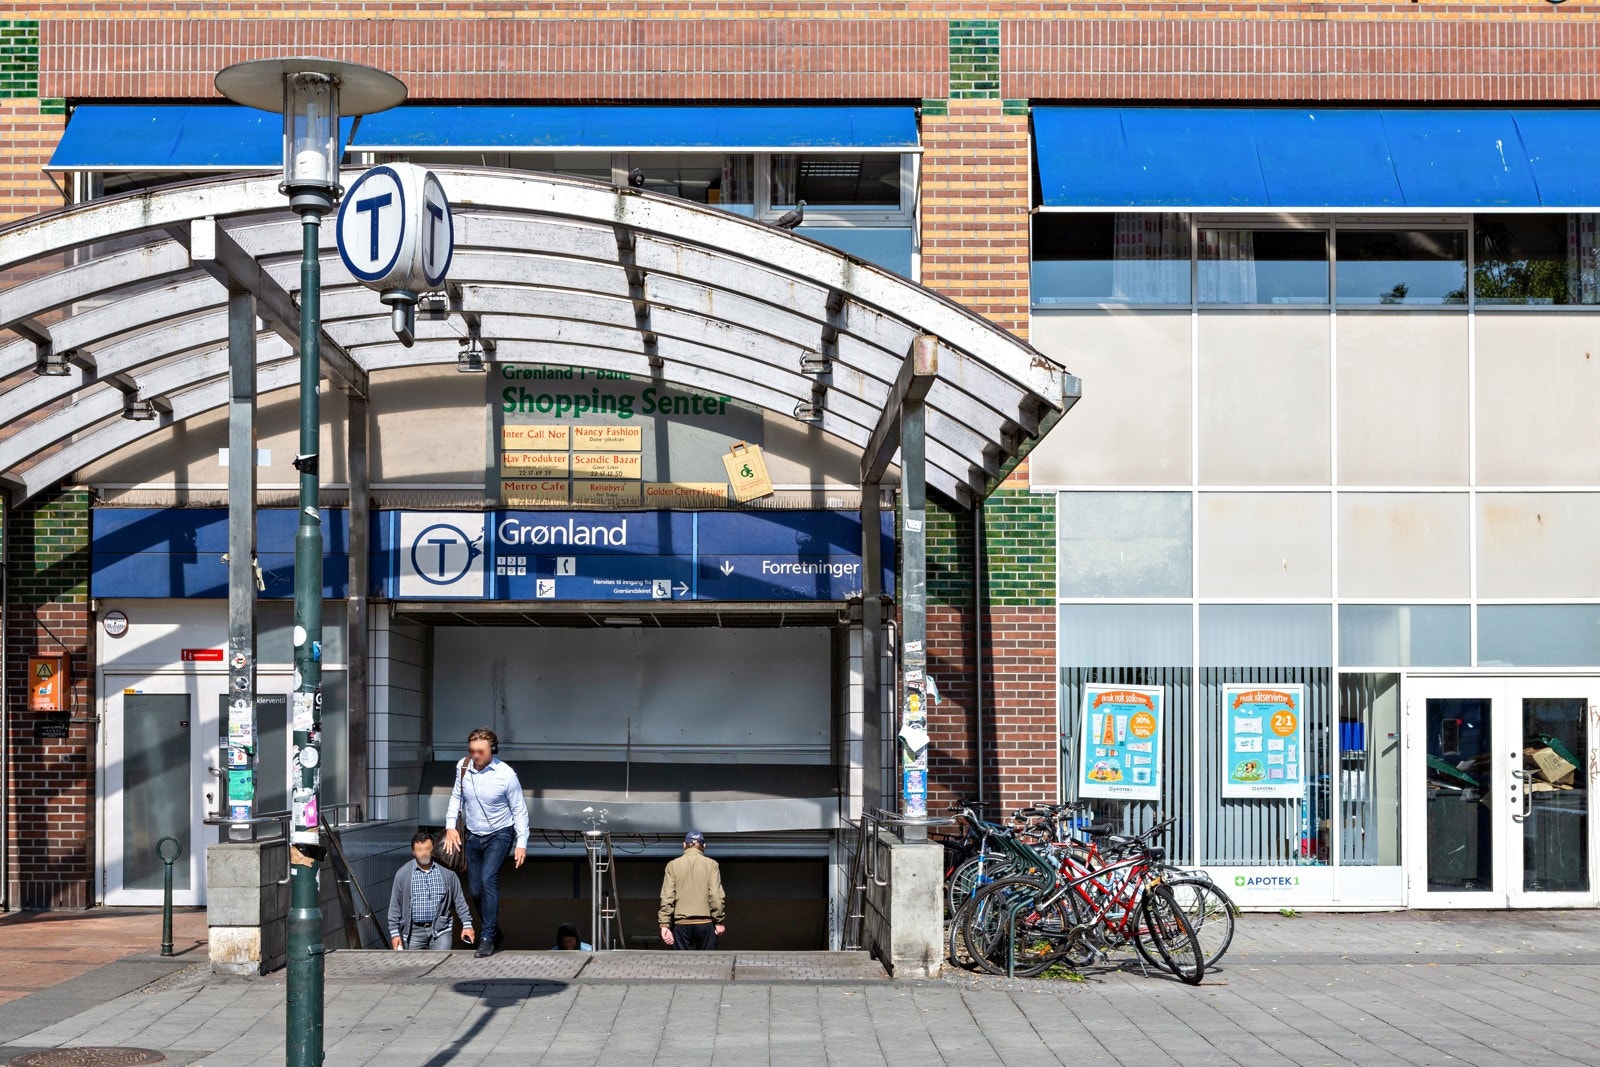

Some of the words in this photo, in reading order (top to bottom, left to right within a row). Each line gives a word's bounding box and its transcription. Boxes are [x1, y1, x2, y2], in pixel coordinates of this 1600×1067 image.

[356, 192, 392, 262] T
[426, 195, 443, 267] T
[502, 365, 573, 380] Grønland
[502, 386, 635, 419] Shopping
[641, 387, 731, 415] Senter
[503, 429, 524, 438] Inter
[527, 429, 544, 438] Call
[548, 429, 566, 438] Nor
[575, 427, 603, 437] Nancy
[606, 427, 639, 436] Fashion
[503, 454, 519, 463] Hav
[523, 454, 566, 463] Produkter
[575, 455, 610, 464] Scandic
[613, 455, 639, 464] Bazar
[505, 482, 537, 491] Metro
[541, 482, 566, 491] Cafe
[647, 488, 673, 496] Golden
[675, 488, 700, 498] Cherry
[498, 518, 627, 546] Grønland
[428, 539, 457, 577] T
[762, 560, 859, 578] Forretninger
[1247, 877, 1292, 885] APOTEK
[1294, 877, 1299, 885] 1
